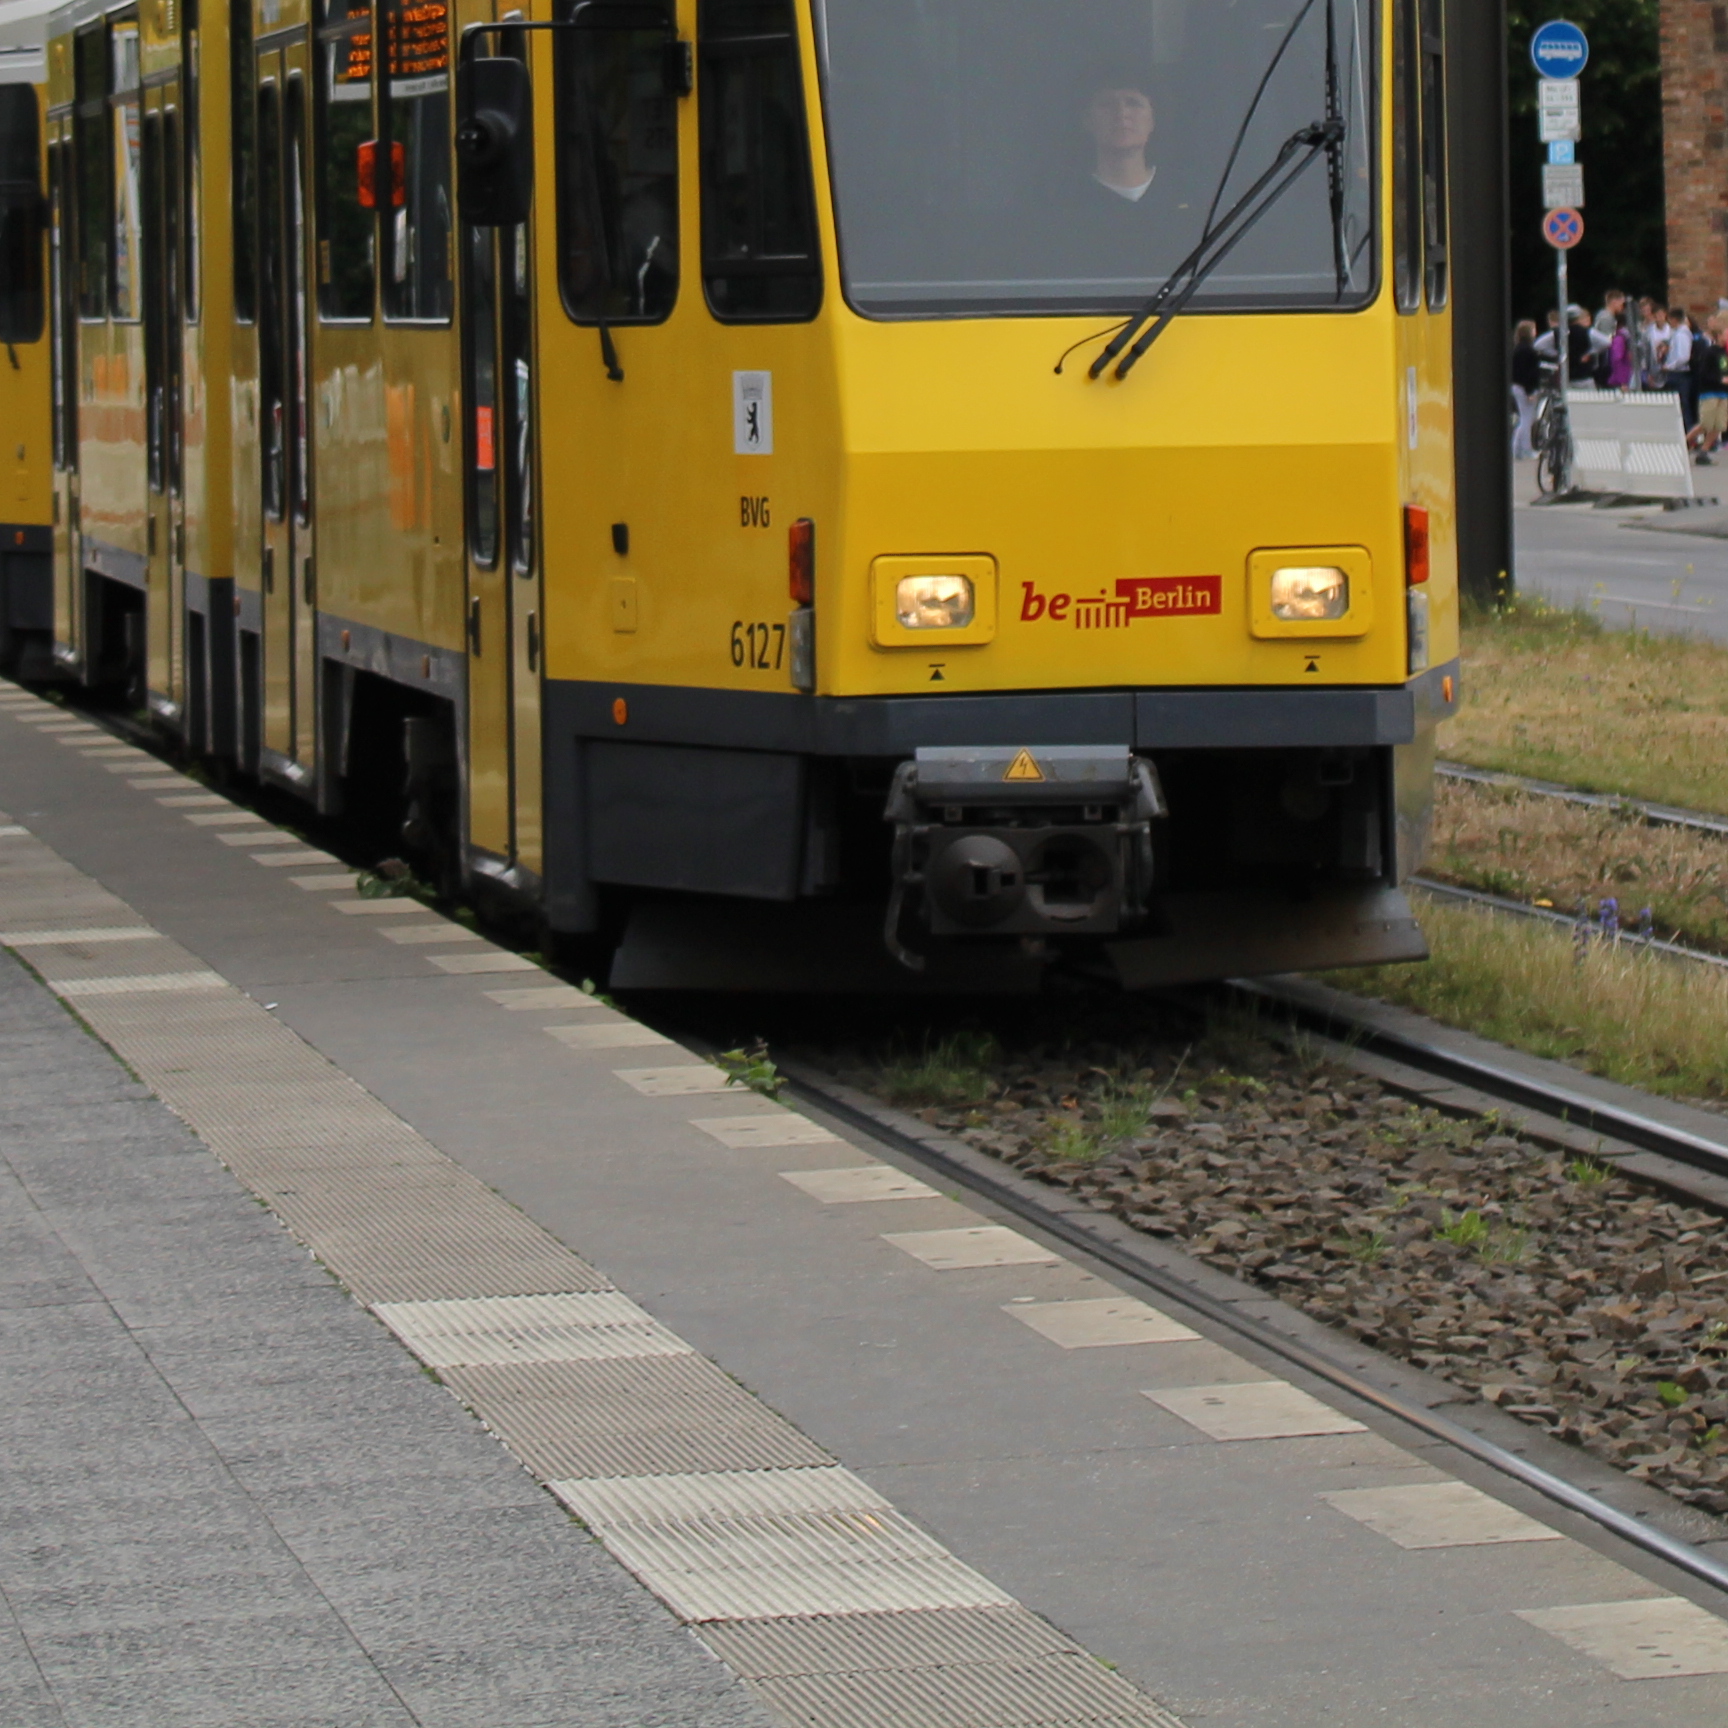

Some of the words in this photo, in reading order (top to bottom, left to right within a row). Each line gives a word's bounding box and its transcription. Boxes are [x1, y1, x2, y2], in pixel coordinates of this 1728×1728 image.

[740, 496, 770, 528] BVG
[1135, 585, 1211, 610] Berlin
[730, 621, 785, 669] 6127
